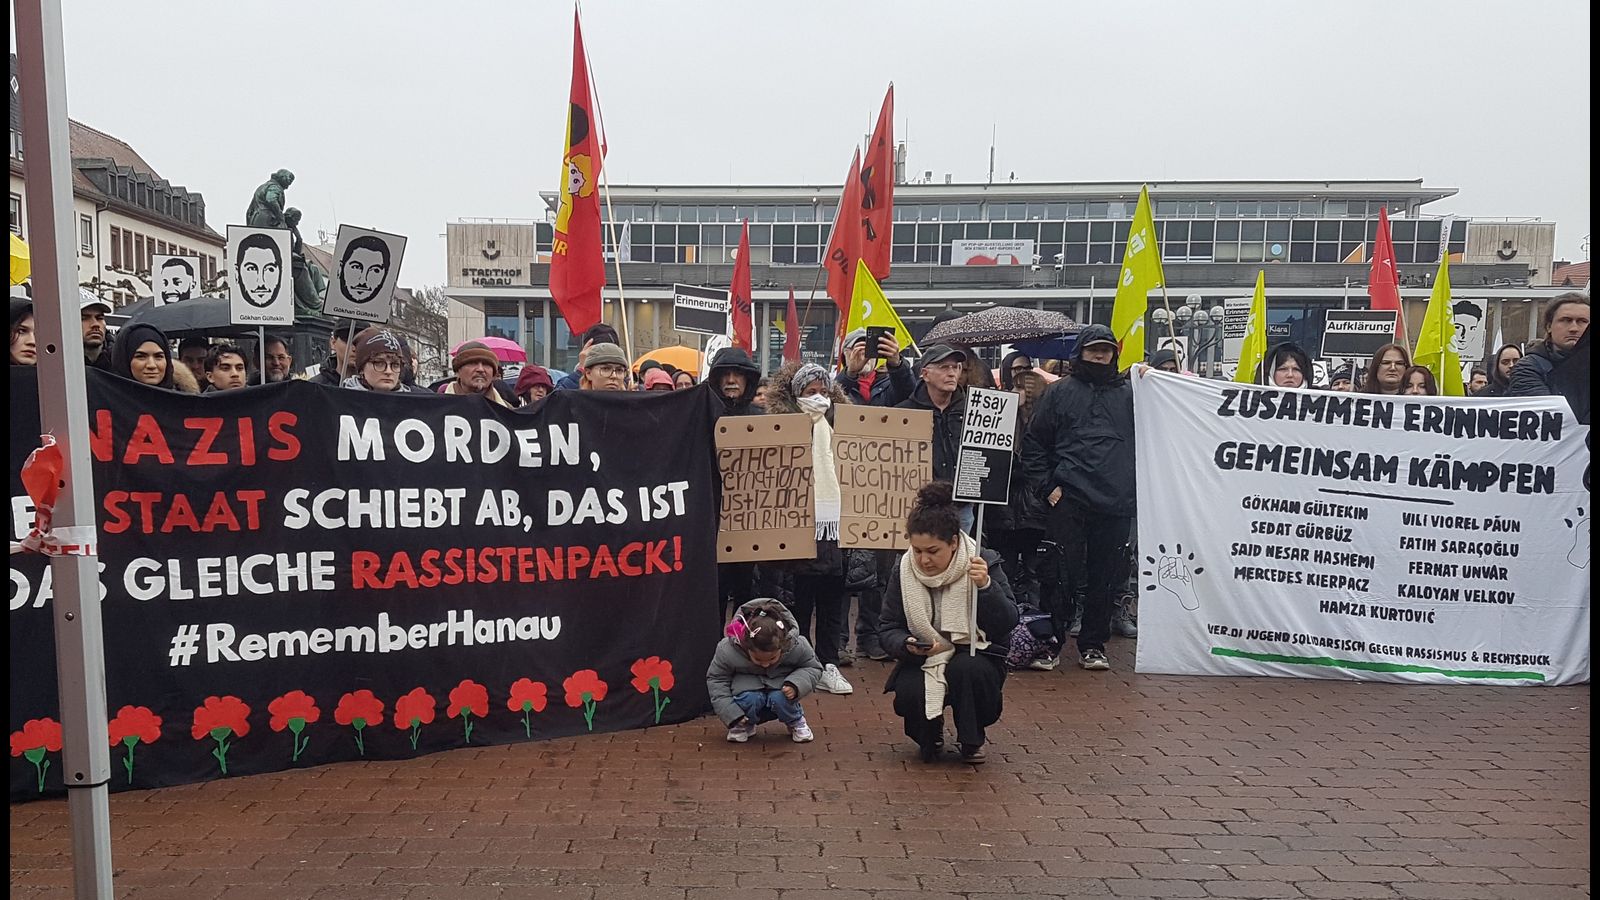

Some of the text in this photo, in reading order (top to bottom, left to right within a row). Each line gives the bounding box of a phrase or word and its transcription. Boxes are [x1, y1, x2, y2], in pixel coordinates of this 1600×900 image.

[462, 268, 522, 277] STADTHOF
[333, 307, 355, 315] Gökhan
[676, 295, 728, 312] Erinnerung!
[1327, 321, 1395, 334] Aufklärung!
[970, 390, 1008, 414] #say
[966, 409, 1002, 429] their
[1217, 389, 1563, 441] ZUSAMMEN ERINNERN
[89, 409, 600, 472] NAZIS MORDEN,
[963, 429, 1013, 447] names
[1214, 441, 1555, 494] GEMEINSAM KÄMPFEN
[103, 481, 690, 533] STAAT SCHIEBT AB, DAS IST
[1242, 494, 1368, 520] GÖKHAN GÜLTEKIN
[1251, 521, 1352, 542] SEDAT GÜRBÜZ
[1431, 515, 1480, 531] VIOREL
[1400, 536, 1436, 551] FATIH
[123, 551, 335, 600] GLEICHE
[351, 535, 683, 589] RASSISTENPACK!
[1231, 543, 1375, 570] SAID NESAR HASHEMI
[1234, 566, 1370, 592] MERCEDES KIERPACZ
[1398, 584, 1515, 604] KALOYAN VELKOV
[1319, 600, 1366, 617] HAMZA
[168, 609, 561, 667] #RememberHanau
[1207, 623, 1243, 638] VER.DI
[1246, 629, 1290, 642] JUGEND
[1368, 643, 1402, 657] GEGEN
[1406, 646, 1467, 662] RASSISMUS
[1471, 652, 1479, 663] &
[1482, 652, 1551, 666] RECHTSRUCK
